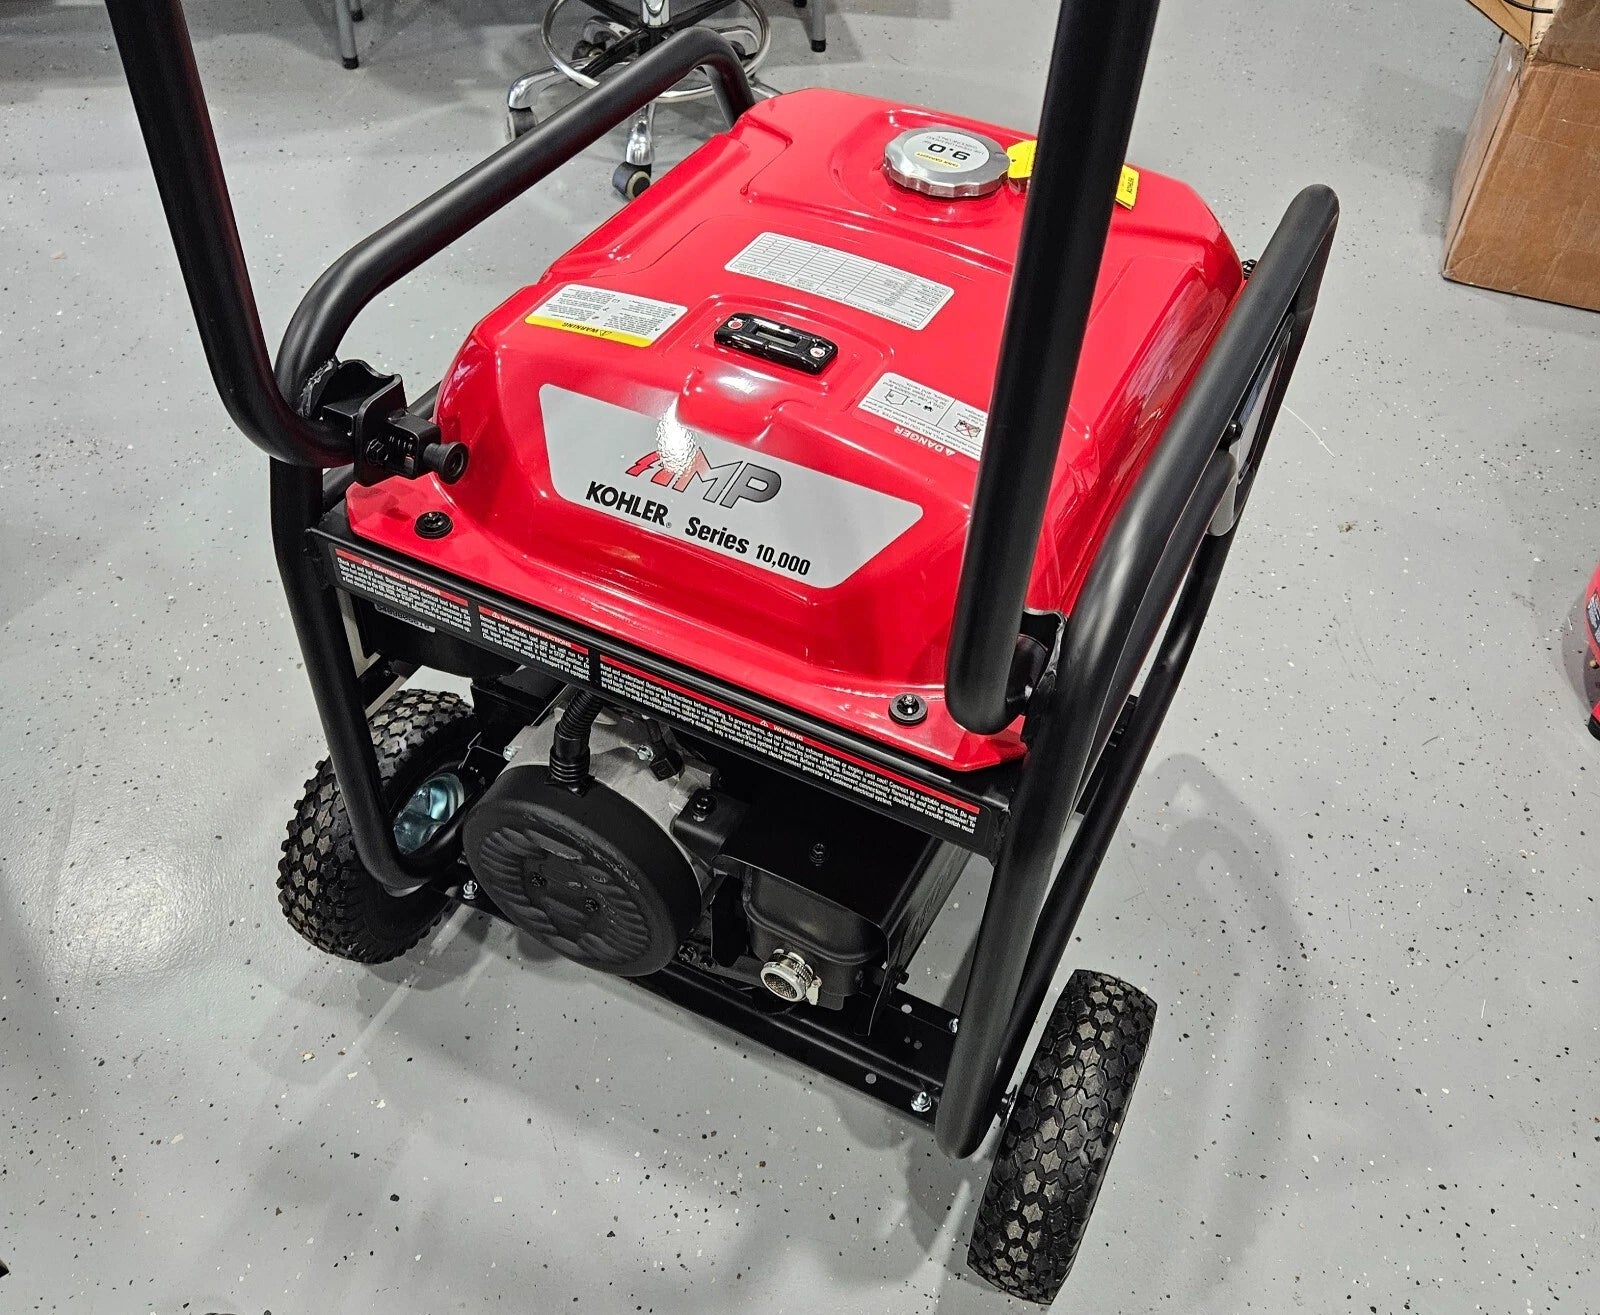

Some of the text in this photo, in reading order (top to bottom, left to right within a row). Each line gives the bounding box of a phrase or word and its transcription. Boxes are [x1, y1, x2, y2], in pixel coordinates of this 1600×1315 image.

[928, 144, 970, 160] 9.0
[562, 322, 599, 333] WARNING
[894, 426, 945, 453] DANGER
[586, 481, 811, 576] KOHLER Series 10,000
[372, 563, 398, 578] STARTING
[501, 614, 528, 631] STOPPING
[773, 724, 803, 741] WARNING
